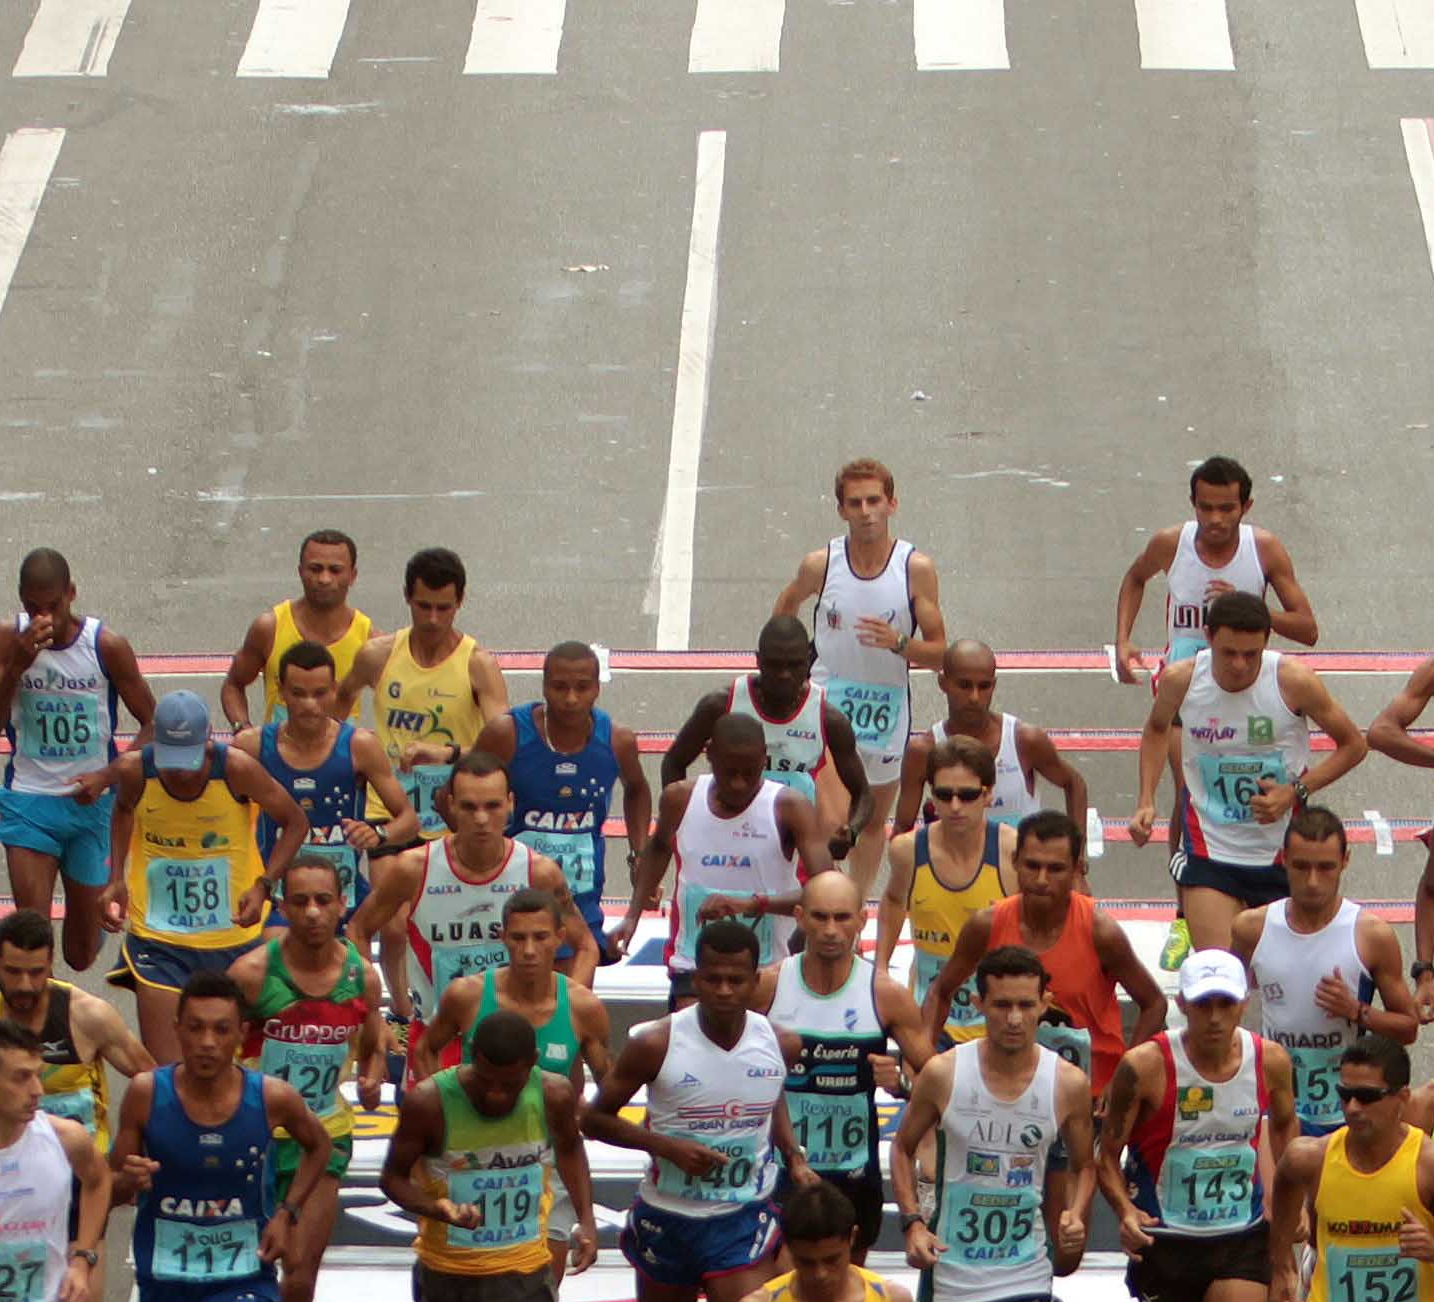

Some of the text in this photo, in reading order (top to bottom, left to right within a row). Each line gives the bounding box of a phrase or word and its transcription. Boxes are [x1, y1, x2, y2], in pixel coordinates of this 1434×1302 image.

[20, 673, 99, 690] ão José
[844, 686, 891, 701] CAIXA
[36, 700, 85, 713] CAIXA
[839, 699, 891, 733] 306
[36, 715, 92, 744] 105
[786, 729, 816, 739] CAIXA
[39, 744, 87, 757] CAIXA
[524, 810, 595, 831] CAIXA
[145, 832, 186, 848] CAIXA
[701, 855, 751, 868] CAIXA
[166, 864, 215, 877] CAIXA
[166, 878, 220, 913] 158
[427, 885, 462, 895] CAIXA
[168, 912, 219, 928] CAIXA
[431, 923, 502, 942] LUAS
[285, 1049, 334, 1065] Rexona
[275, 1064, 340, 1098] 120
[800, 1099, 853, 1115] Rexona
[791, 1115, 865, 1150] 116
[472, 1174, 529, 1190] CAIXA
[1181, 1169, 1250, 1206] 143
[160, 1198, 244, 1217] CAIXA
[473, 1189, 531, 1227] 119
[1186, 1205, 1239, 1220] CAIXA
[472, 1223, 527, 1242] CAIXA
[955, 1207, 1033, 1244] 305
[172, 1244, 246, 1274] 117
[965, 1246, 1020, 1259] CAIXA
